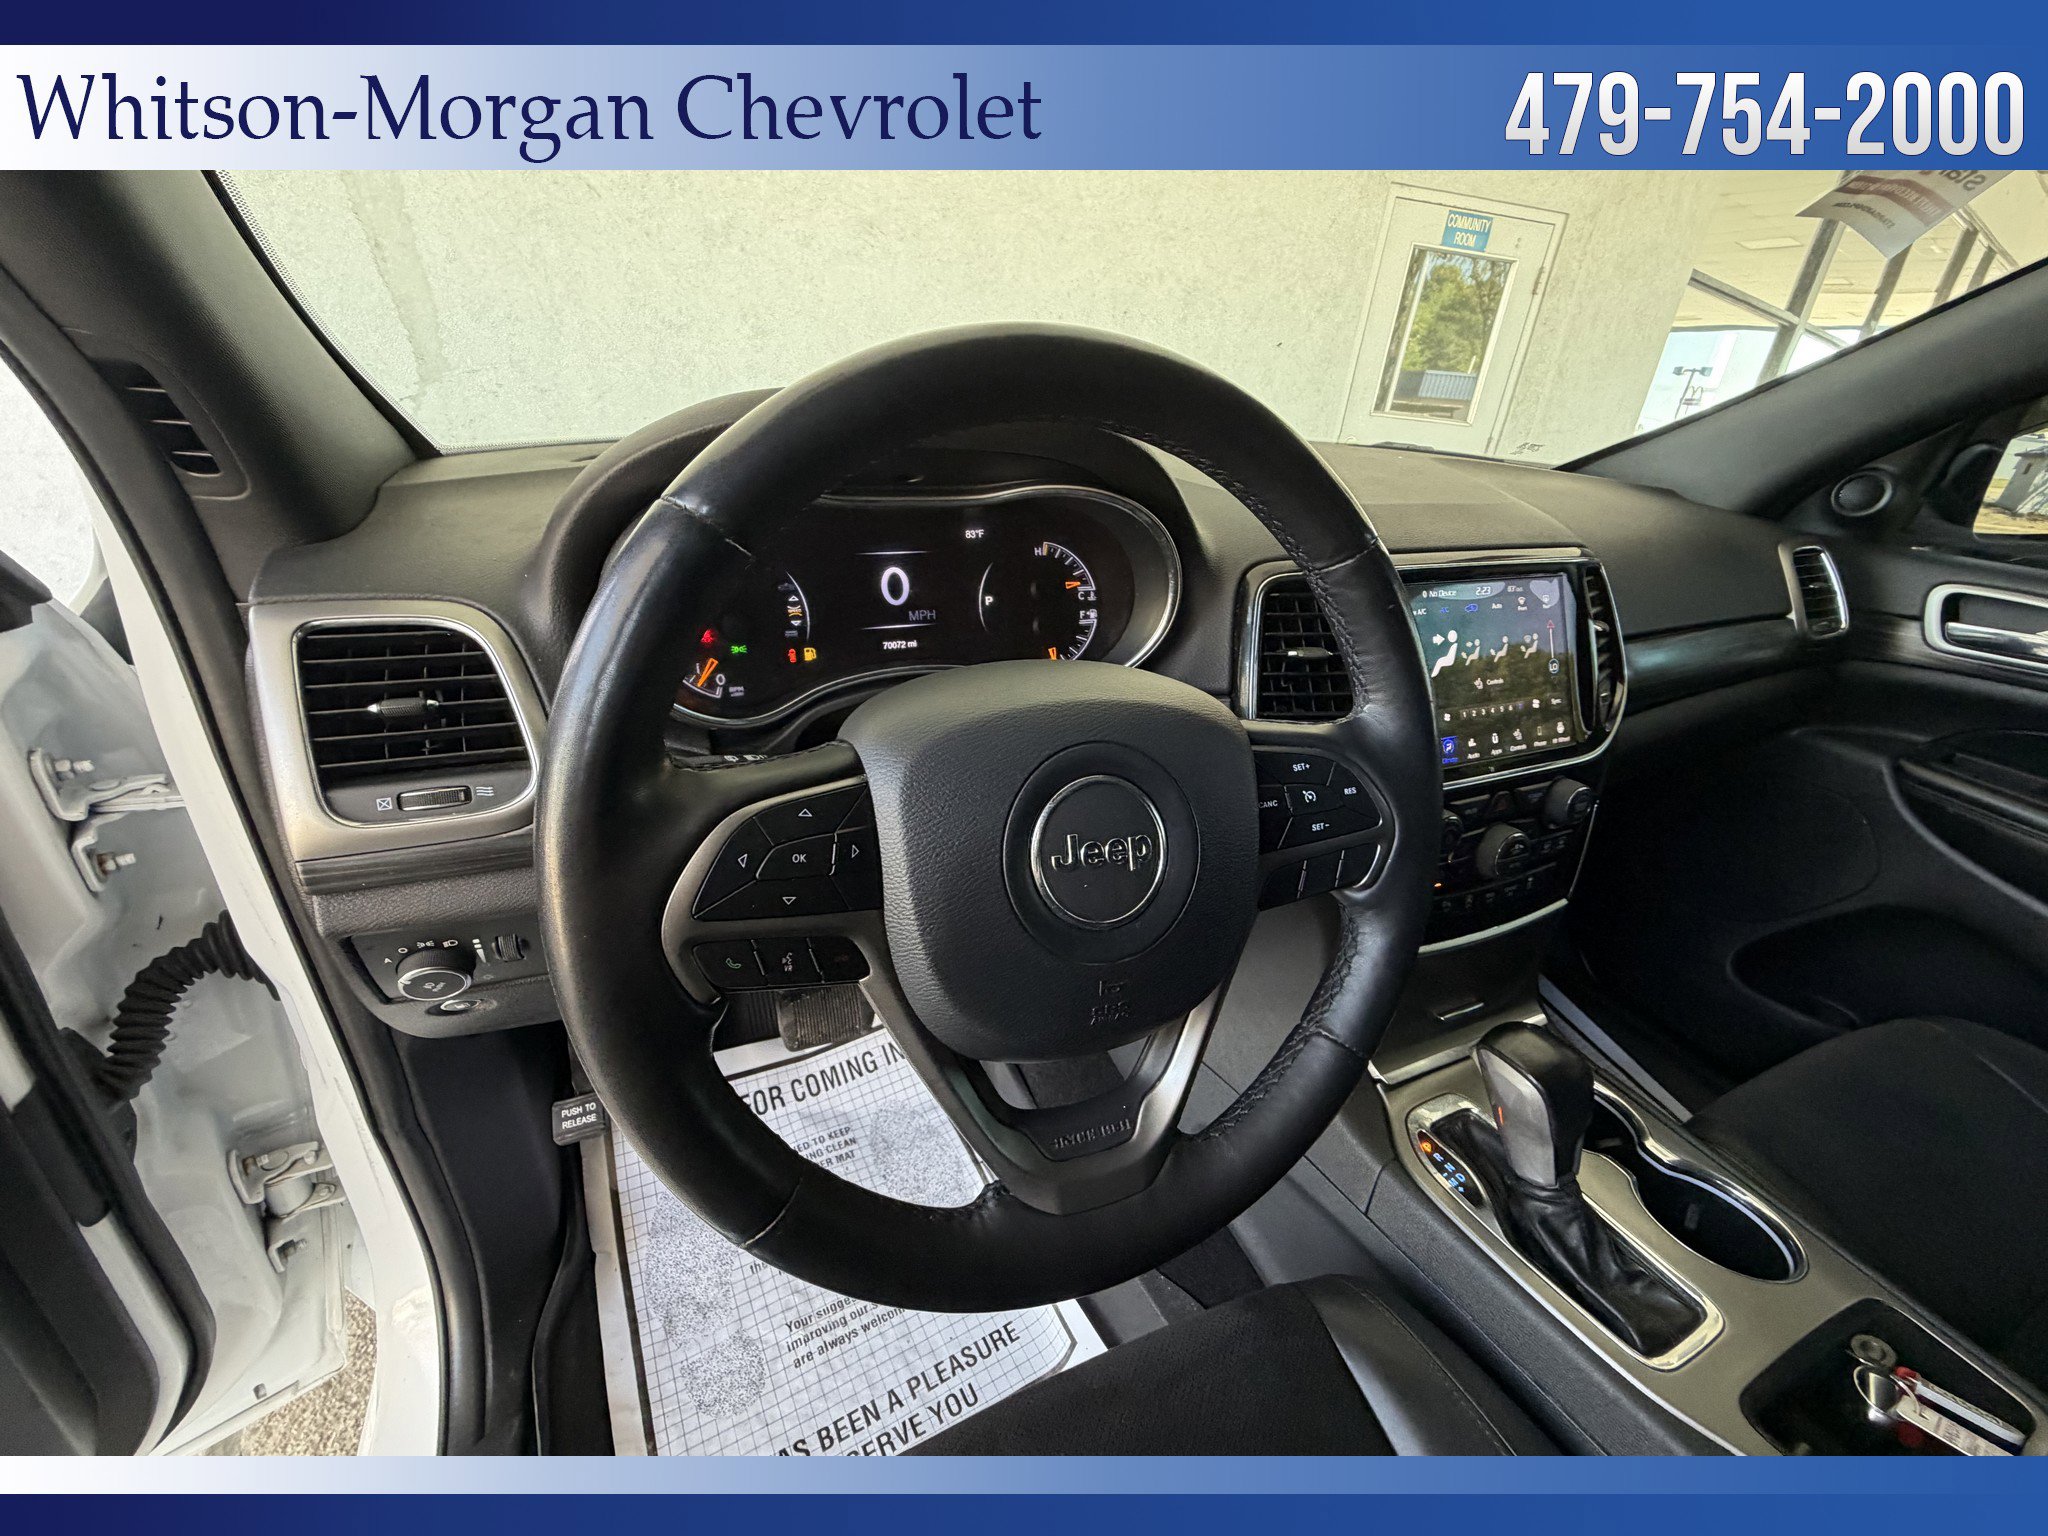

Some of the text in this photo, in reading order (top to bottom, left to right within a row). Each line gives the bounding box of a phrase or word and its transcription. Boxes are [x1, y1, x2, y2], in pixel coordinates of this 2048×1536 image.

[1447, 213, 1491, 233] COMMUNITY
[1454, 231, 1477, 247] ROOM
[881, 566, 910, 606] 0
[985, 596, 994, 606] P
[1077, 591, 1086, 601] C
[908, 609, 936, 621] MPH
[1079, 611, 1085, 619] F
[883, 639, 918, 650] 70072 mi
[1343, 786, 1357, 795] RES
[792, 853, 807, 863] OK
[1051, 833, 1153, 872] Jeep
[790, 1050, 878, 1103] COMING
[561, 1102, 597, 1118] PUSH TO
[561, 1113, 597, 1129] RELEASE
[812, 1135, 826, 1146] TO
[828, 1126, 851, 1141] KEEP
[825, 1137, 857, 1154] CLEAN
[835, 1150, 856, 1164] MAT
[785, 1314, 814, 1333] Your
[786, 1314, 847, 1353] improving
[850, 1305, 869, 1321] our
[793, 1350, 814, 1369] are
[817, 1326, 859, 1356] always
[816, 1398, 882, 1453] BEEN
[886, 1388, 905, 1415] A
[905, 1321, 1020, 1400] PLEASURE
[846, 1382, 979, 1456] ERVE YOU
